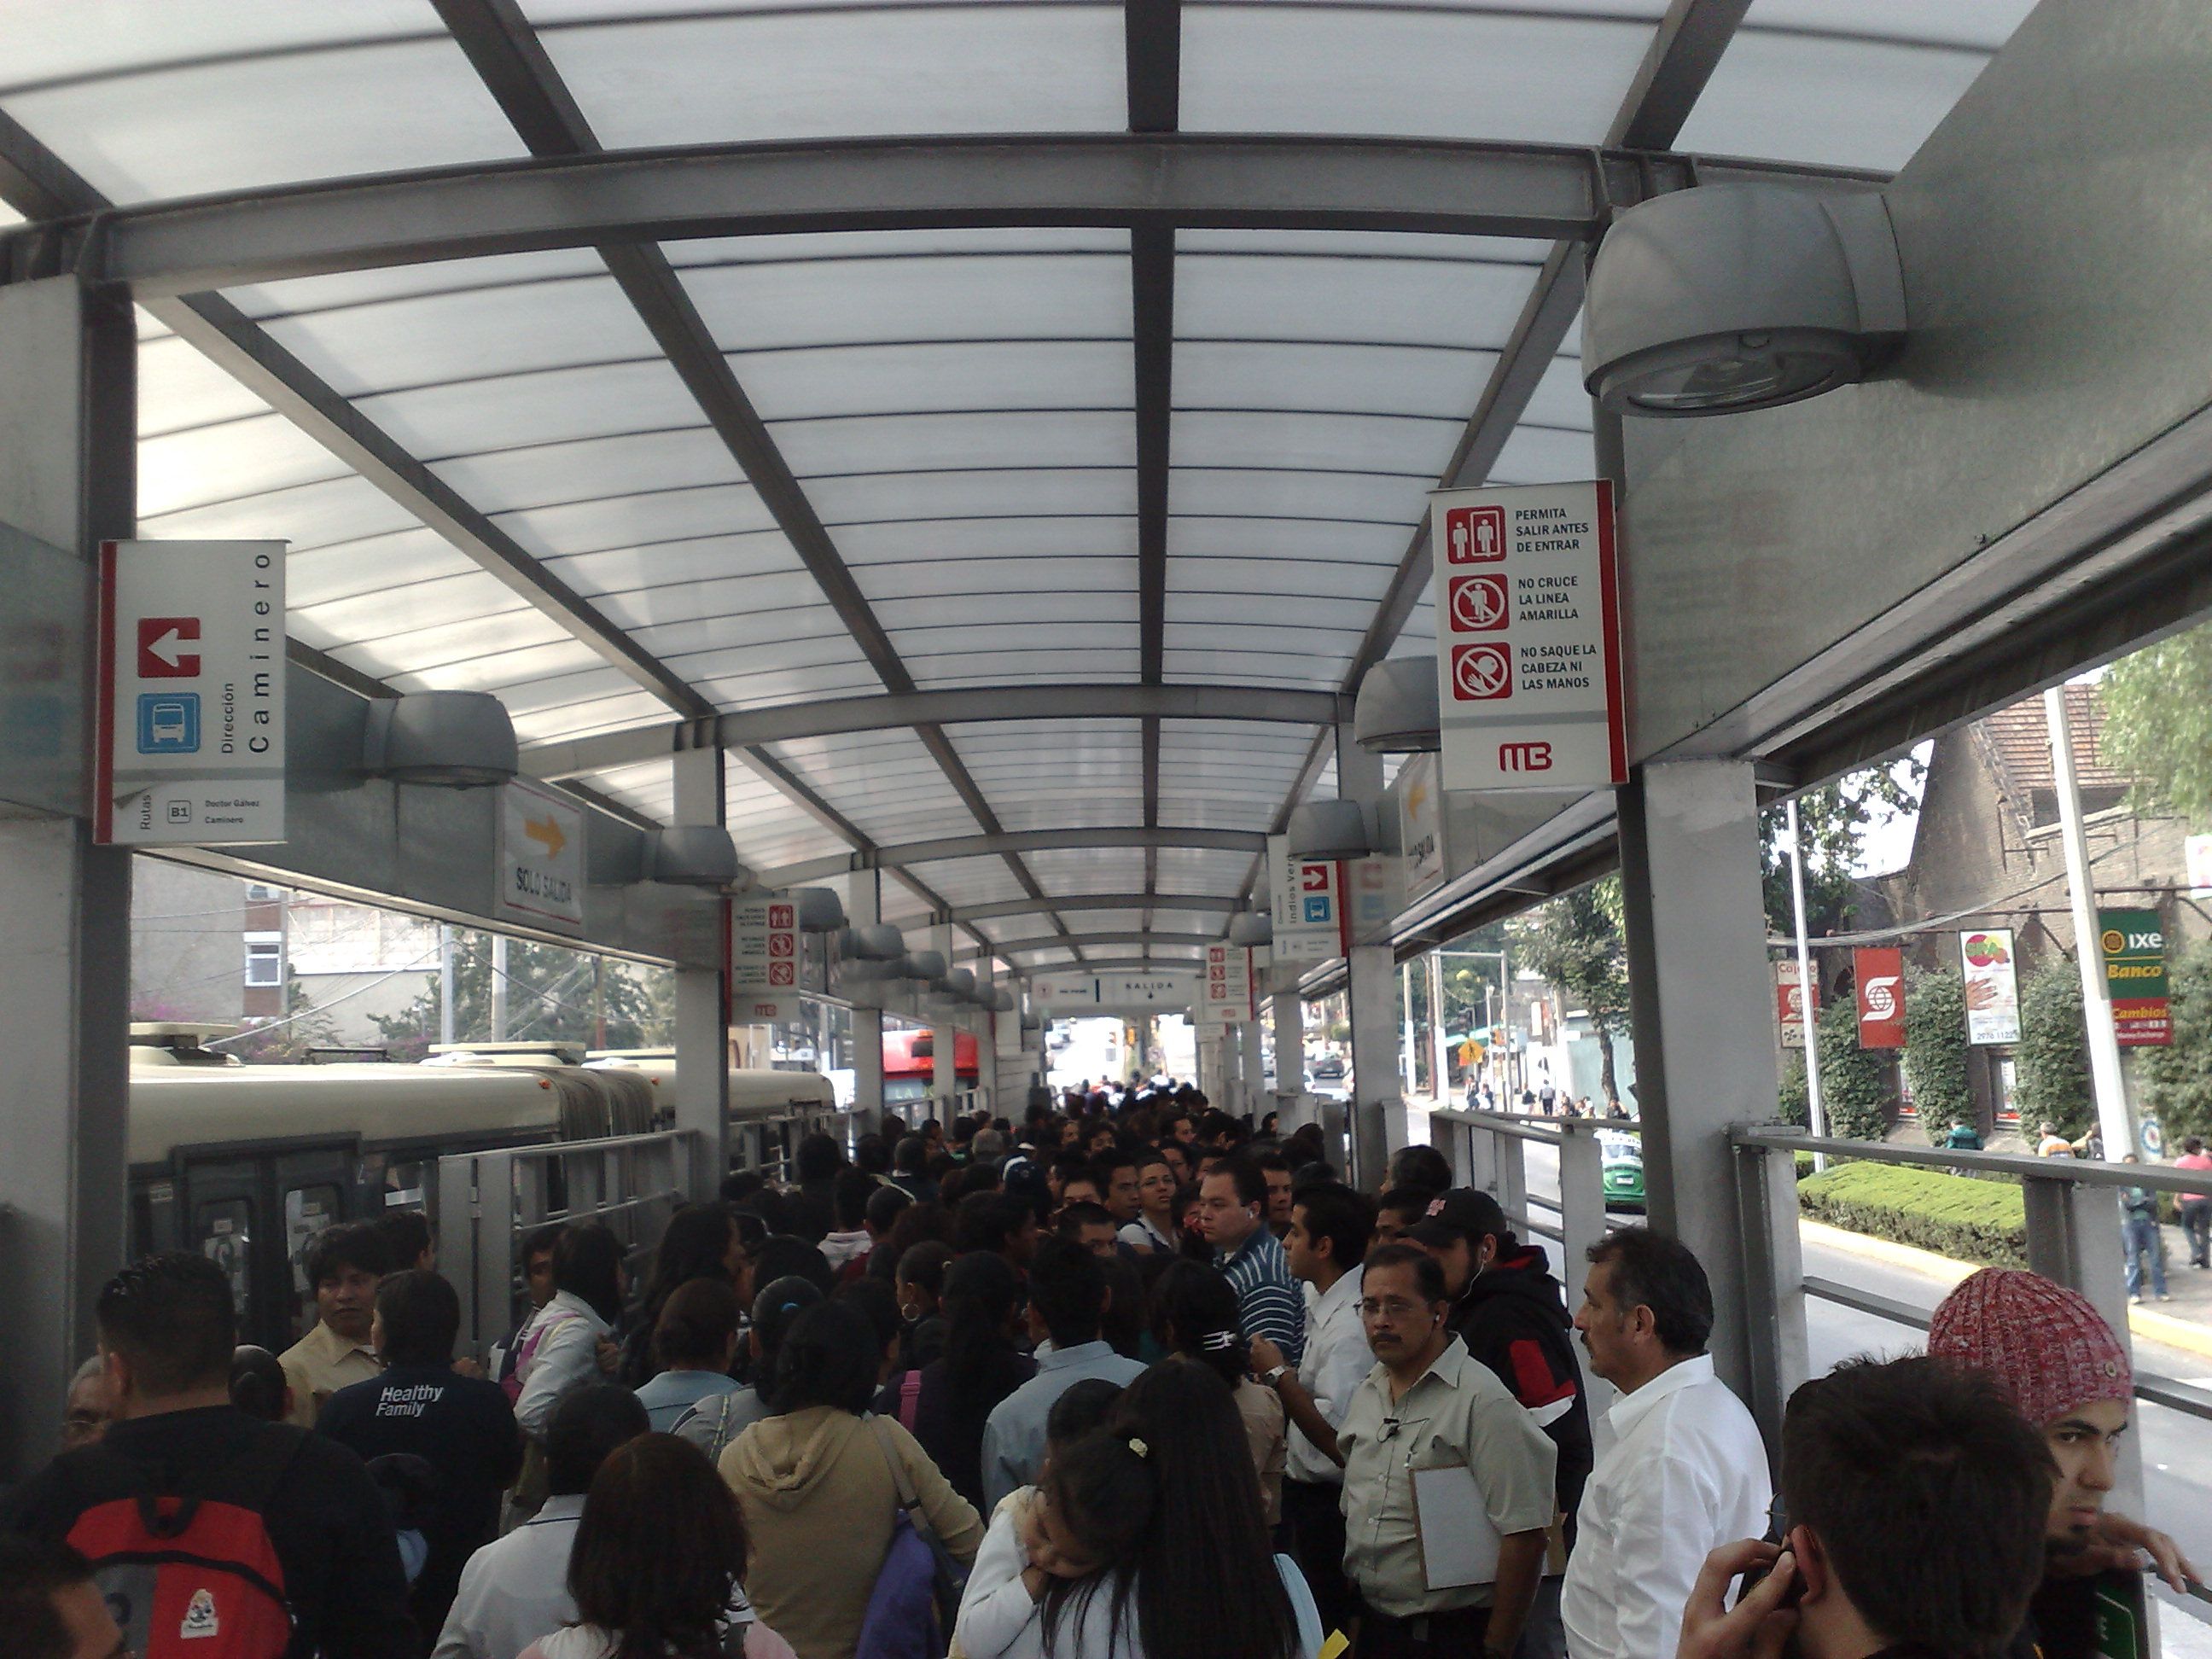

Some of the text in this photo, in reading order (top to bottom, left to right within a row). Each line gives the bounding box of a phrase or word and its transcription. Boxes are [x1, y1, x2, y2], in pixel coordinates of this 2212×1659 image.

[1516, 509, 1567, 521] PERMITA
[1516, 523, 1589, 536] SALIR ANTES
[1516, 539, 1580, 552] DE ENTRAR
[1518, 576, 1578, 589] NO CRUCE
[1519, 592, 1569, 605] LA LINEA
[1519, 608, 1579, 621] AMARILLA
[249, 554, 271, 754] Caminero
[1521, 644, 1597, 658] NO SAQUE LA
[1522, 661, 1582, 674] CABEZA NI
[1522, 677, 1590, 690] LAS MANOS
[222, 683, 234, 754] Dirección
[140, 795, 152, 830] Rutas
[171, 807, 189, 818] B1
[2107, 964, 2163, 978] Banco
[2112, 1006, 2168, 1020] Cambios
[380, 1383, 444, 1402] Healthy
[375, 1401, 425, 1418] Family
